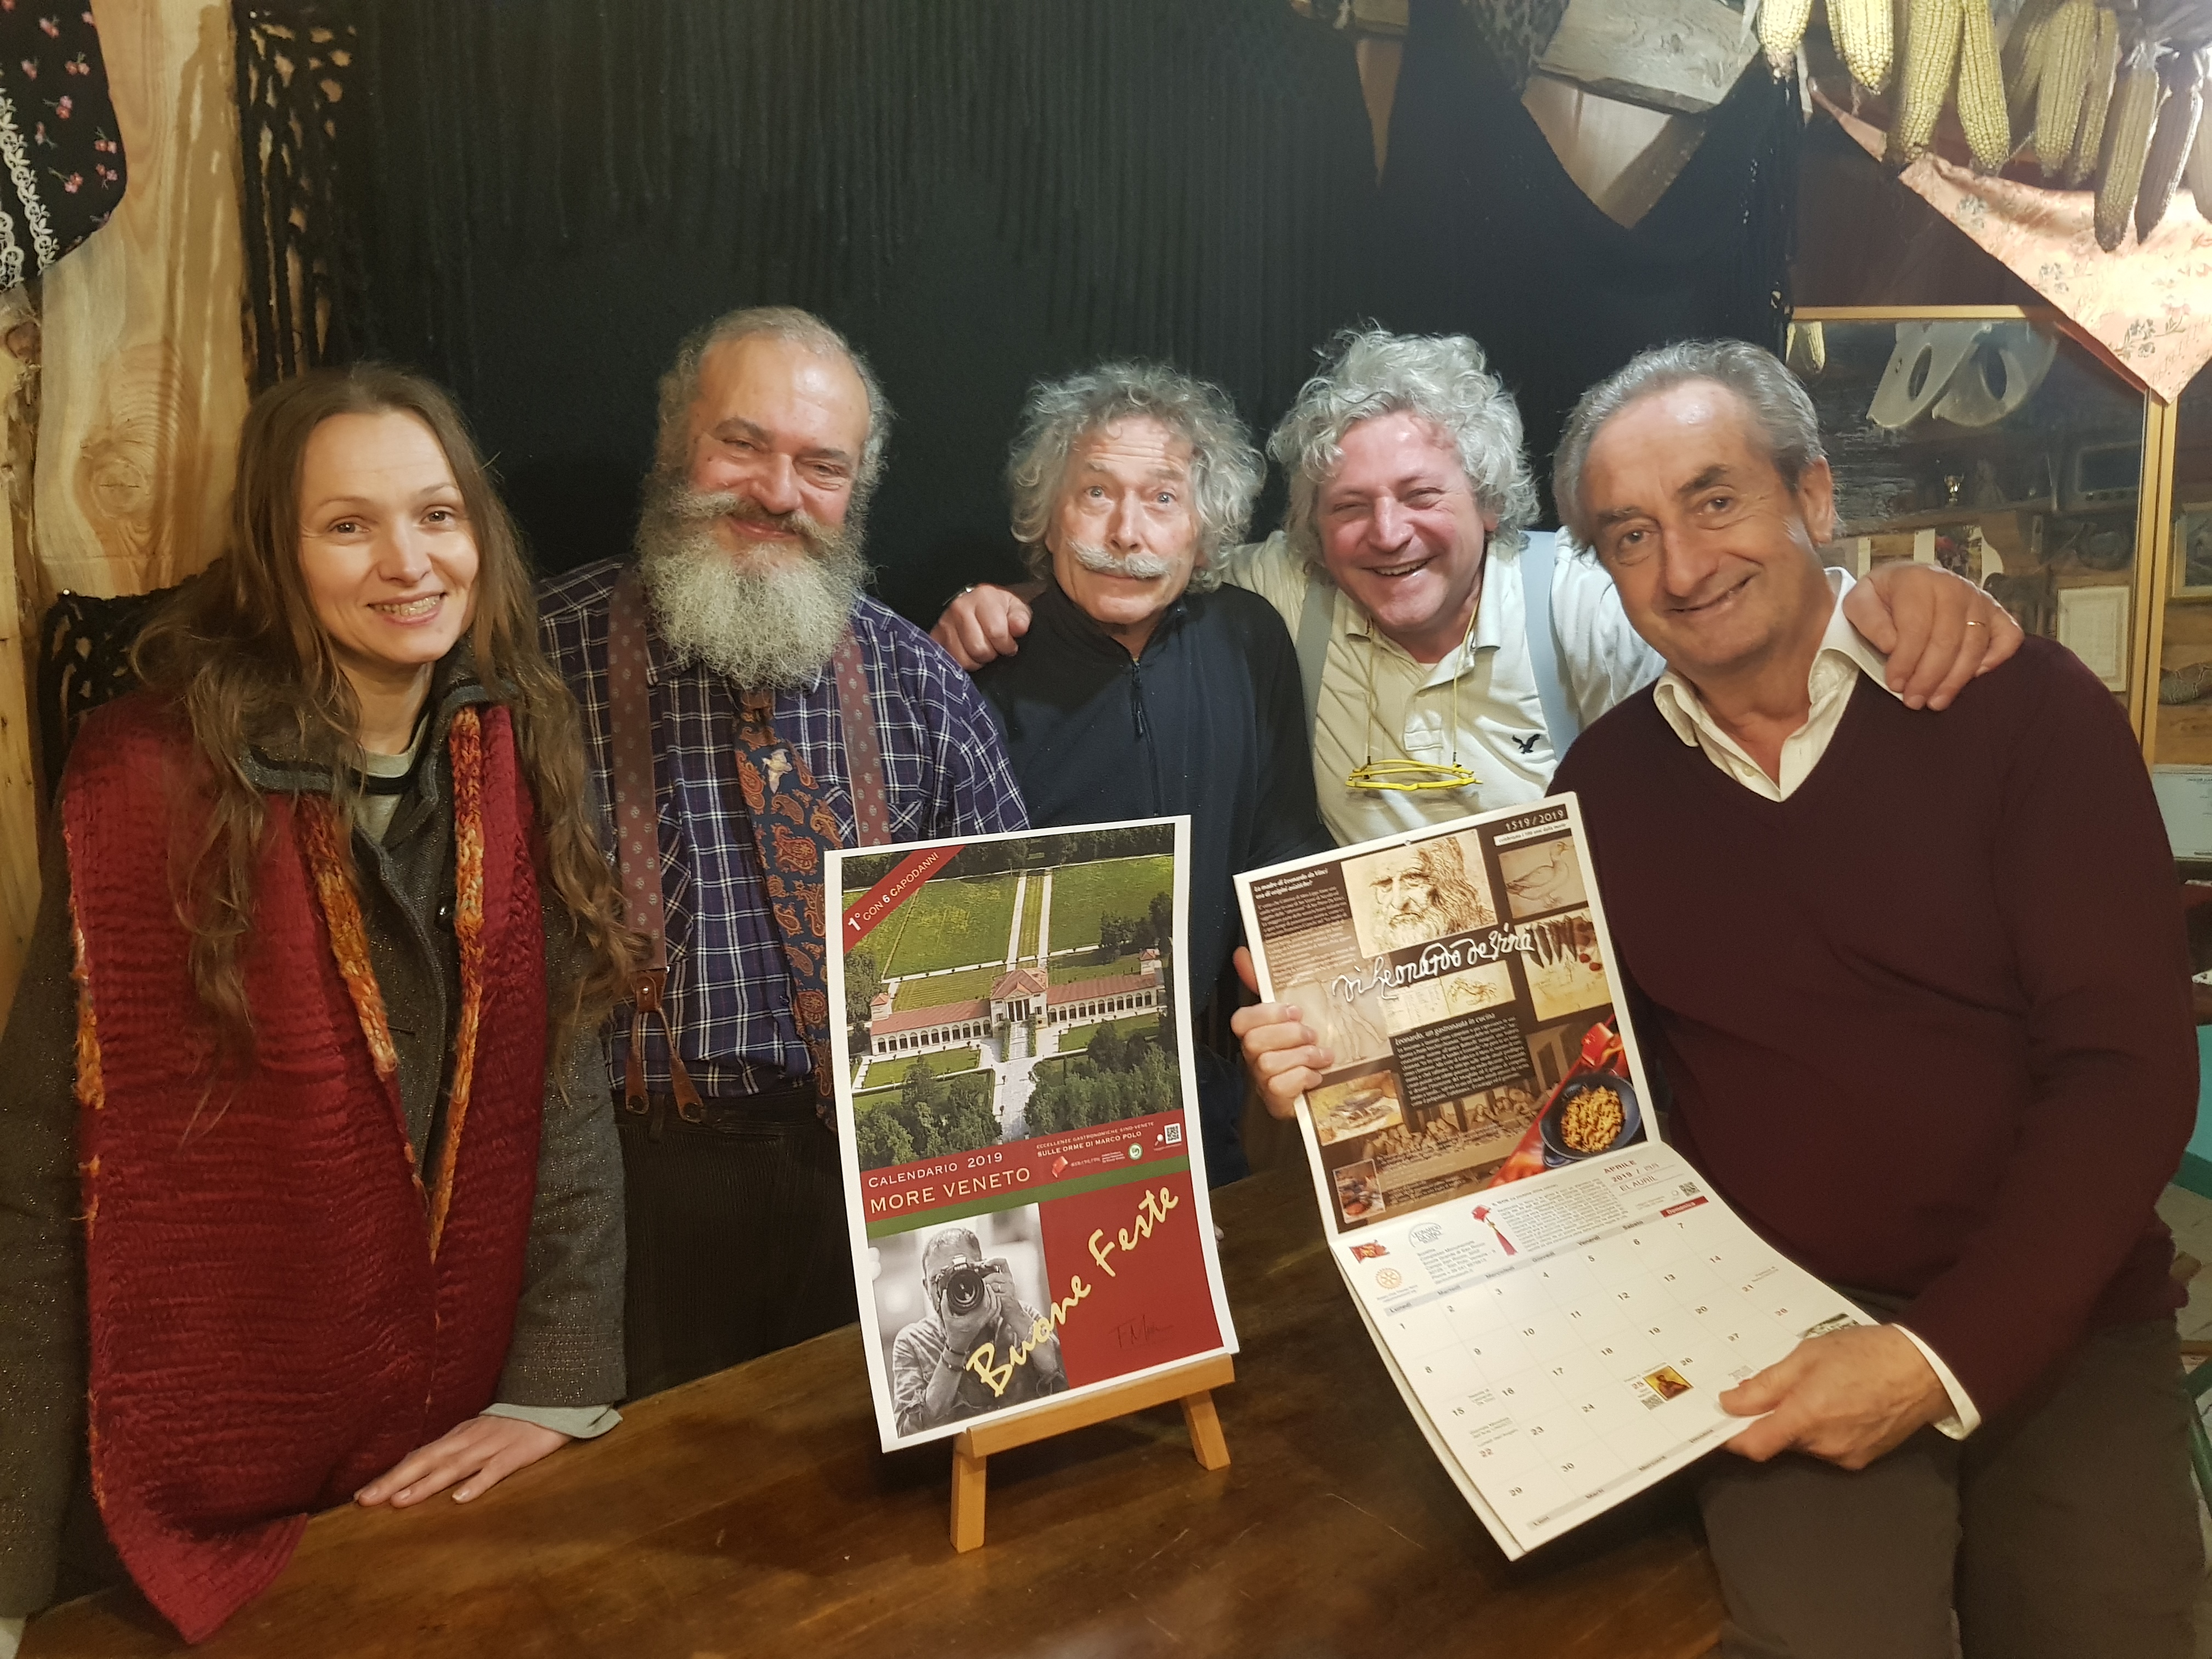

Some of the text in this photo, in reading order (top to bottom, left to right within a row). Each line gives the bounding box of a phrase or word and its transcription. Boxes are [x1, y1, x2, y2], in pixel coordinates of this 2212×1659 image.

[863, 901, 884, 921] CON
[882, 895, 890, 903] 6
[890, 852, 939, 896] CAPODANNI
[1036, 1138, 1071, 1150] ECCELLENZE
[1073, 1129, 1119, 1142] GASTRONOMICHE
[1037, 1148, 1061, 1158] SULLE
[1063, 1143, 1084, 1153] ORME
[1095, 1135, 1120, 1146] MARCO
[1122, 1131, 1142, 1140] POLO
[967, 1152, 1003, 1168] 2019
[870, 1167, 1030, 1214] MORE VENETO
[1664, 1273, 1676, 1282] 13
[966, 1187, 1179, 1397] Buone Feste
[1617, 1292, 1630, 1301] 12
[1570, 1310, 1582, 1319] 11
[1695, 1306, 1708, 1314] 20
[1522, 1328, 1535, 1336] 10
[1552, 1367, 1564, 1376] 17
[1452, 1407, 1465, 1416] 15
[1531, 1426, 1545, 1436] 23
